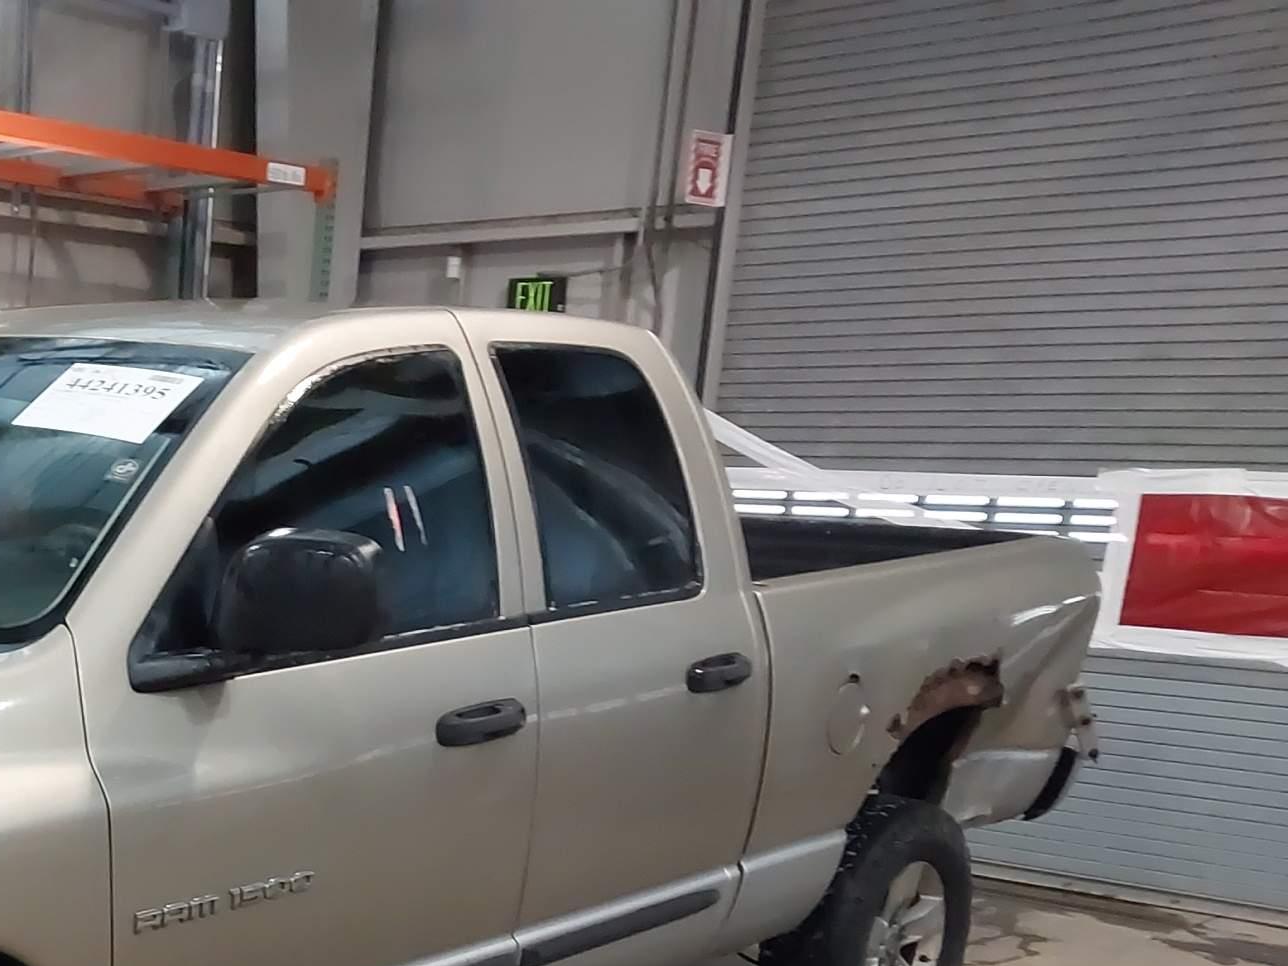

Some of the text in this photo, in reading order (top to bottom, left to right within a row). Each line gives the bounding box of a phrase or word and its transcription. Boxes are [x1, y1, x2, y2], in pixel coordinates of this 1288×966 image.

[515, 281, 554, 312] EXIT
[66, 378, 171, 400] 44241395
[133, 894, 220, 935] RAM
